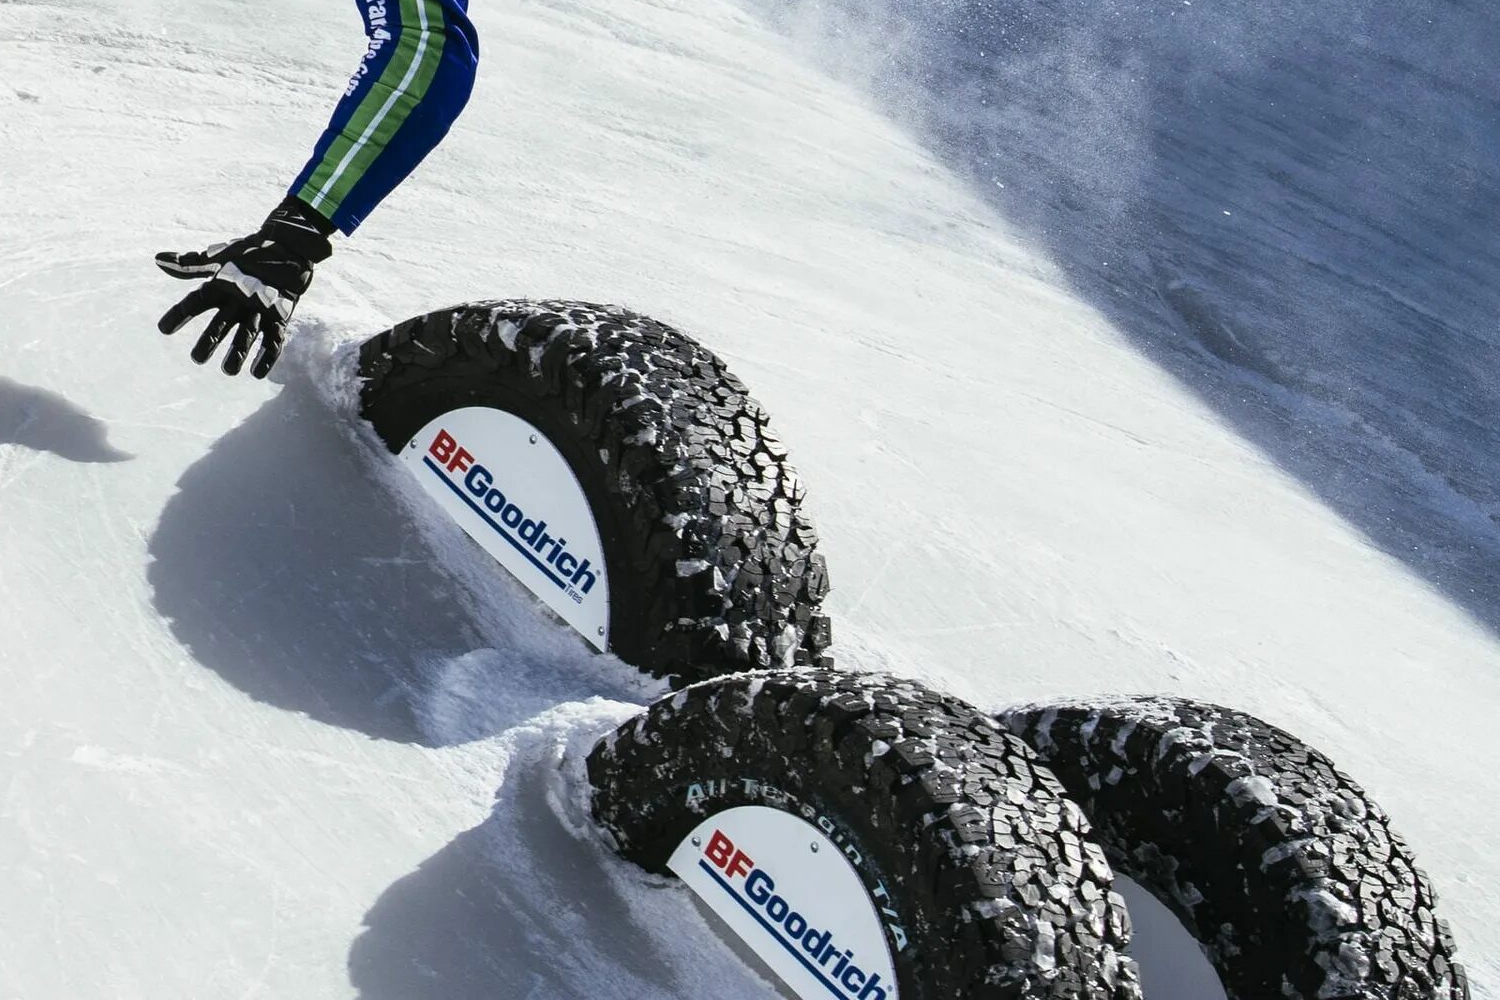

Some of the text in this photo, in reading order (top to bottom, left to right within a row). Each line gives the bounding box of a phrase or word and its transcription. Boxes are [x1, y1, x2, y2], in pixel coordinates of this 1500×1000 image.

[429, 429, 596, 594] BFGoodrich
[704, 829, 887, 1000] BFGoodrich
[872, 879, 908, 952] T/A
